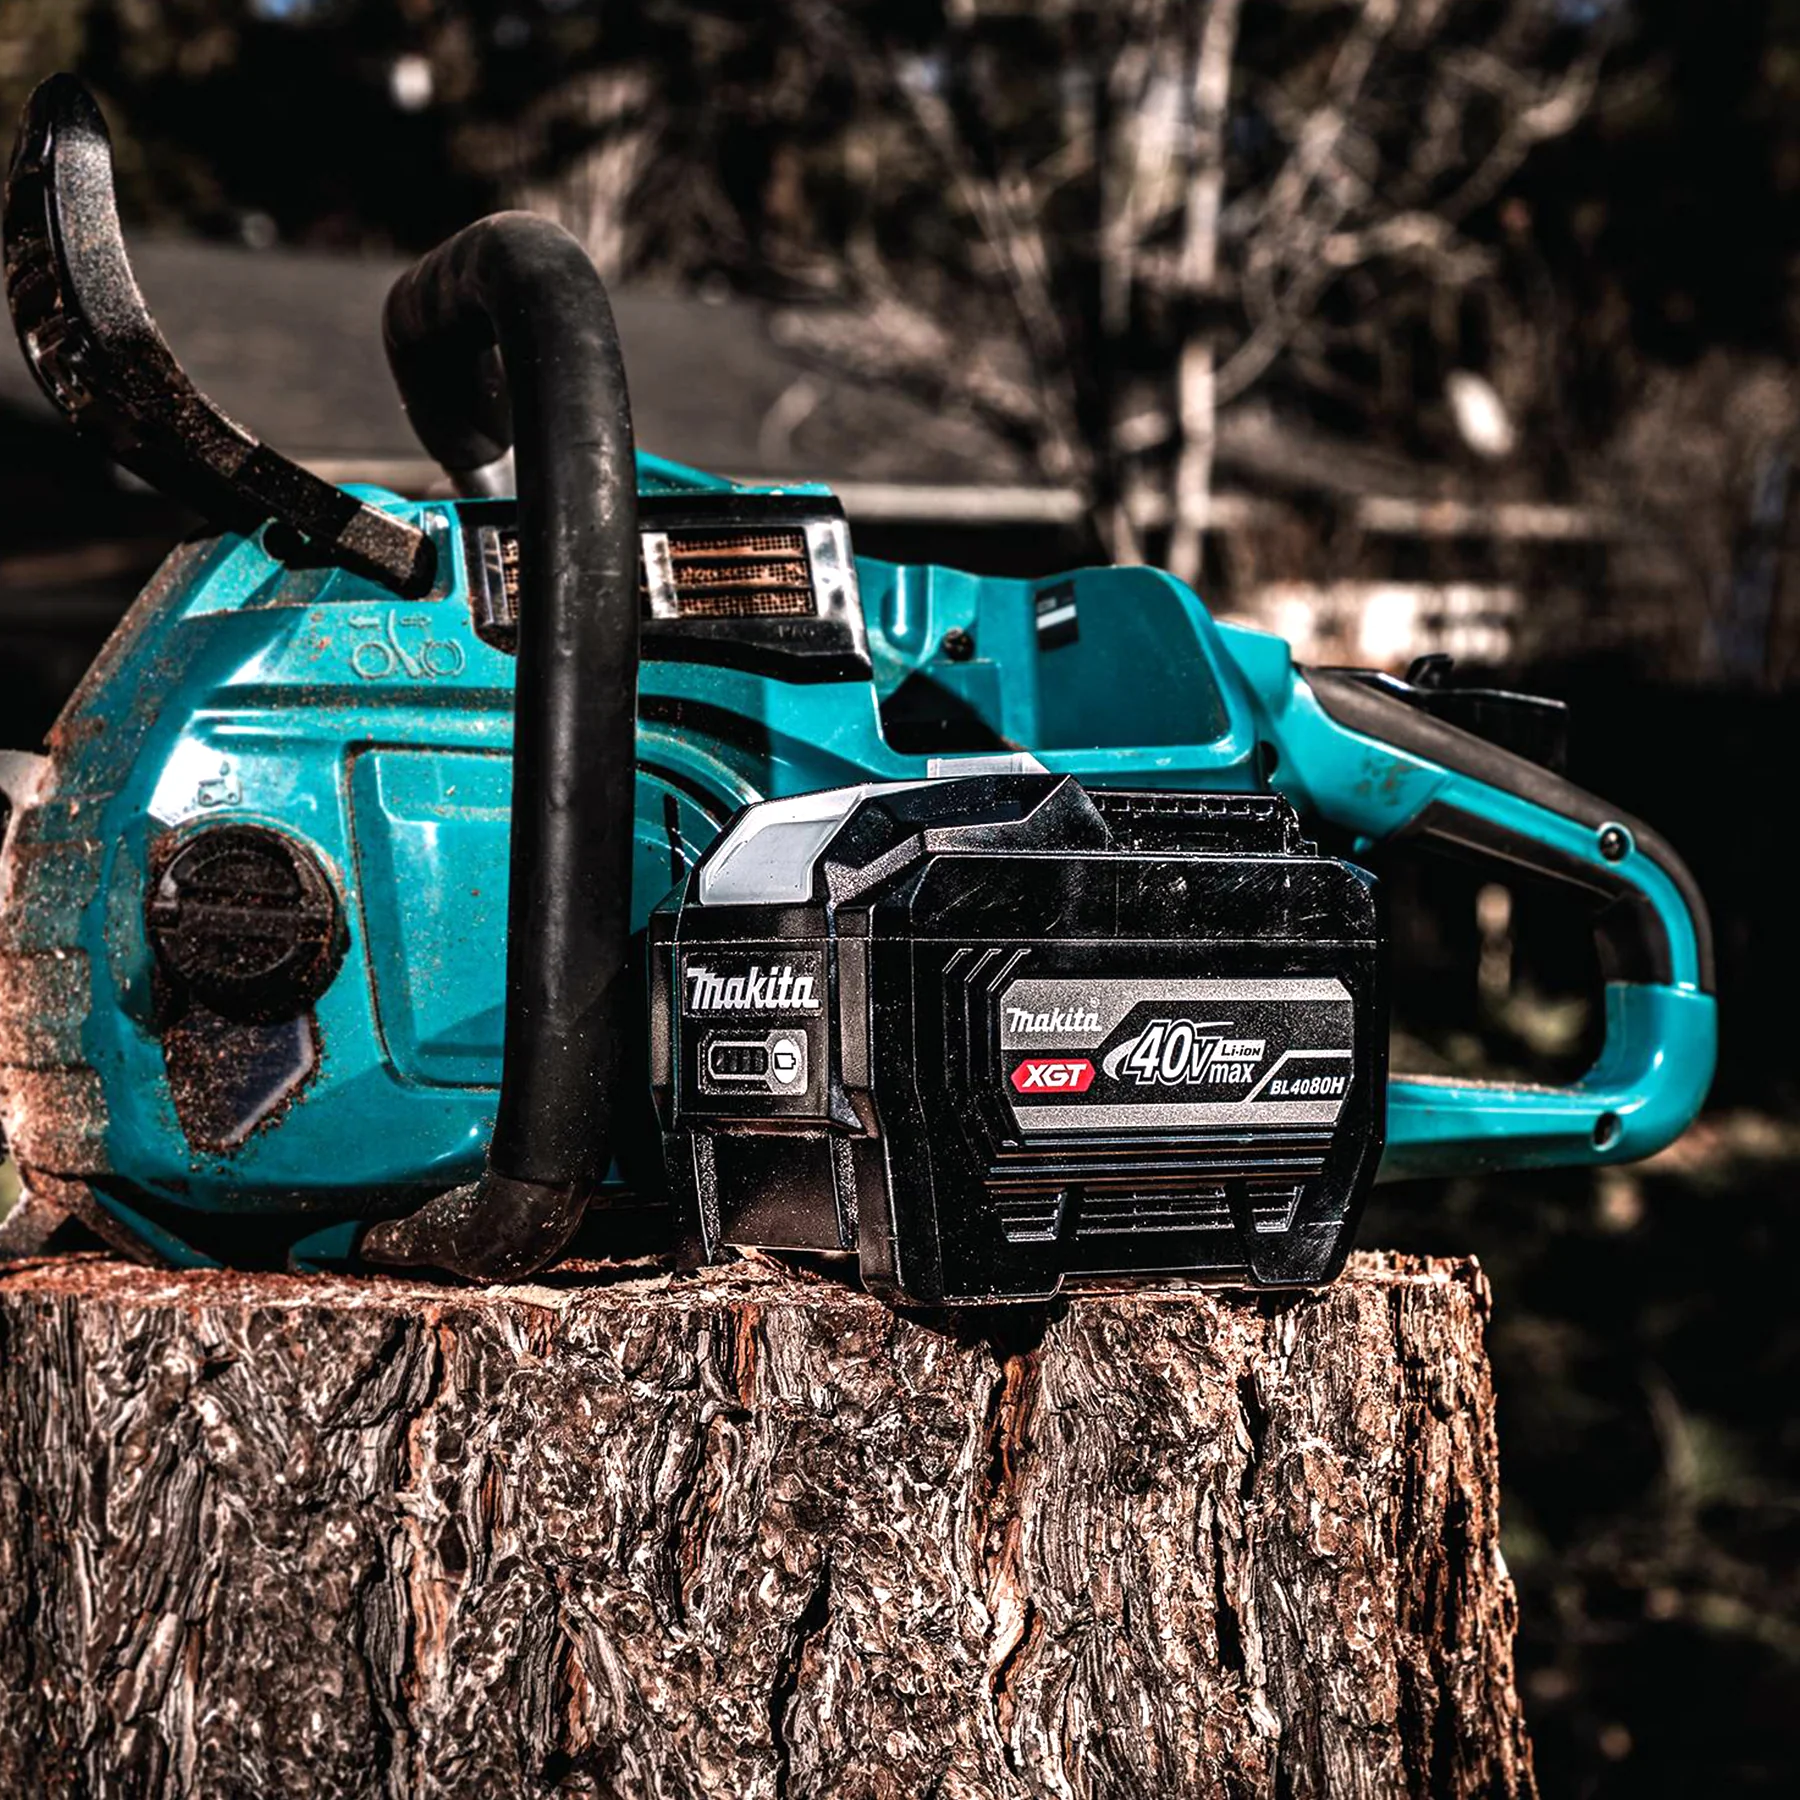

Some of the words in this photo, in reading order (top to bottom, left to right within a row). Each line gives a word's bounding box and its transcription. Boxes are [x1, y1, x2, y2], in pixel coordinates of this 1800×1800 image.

[686, 966, 819, 1009] Makita
[1006, 1008, 1102, 1033] Makita
[1022, 1064, 1087, 1087] XGT
[1209, 1062, 1254, 1084] max
[1270, 1076, 1346, 1096] BL4080H
